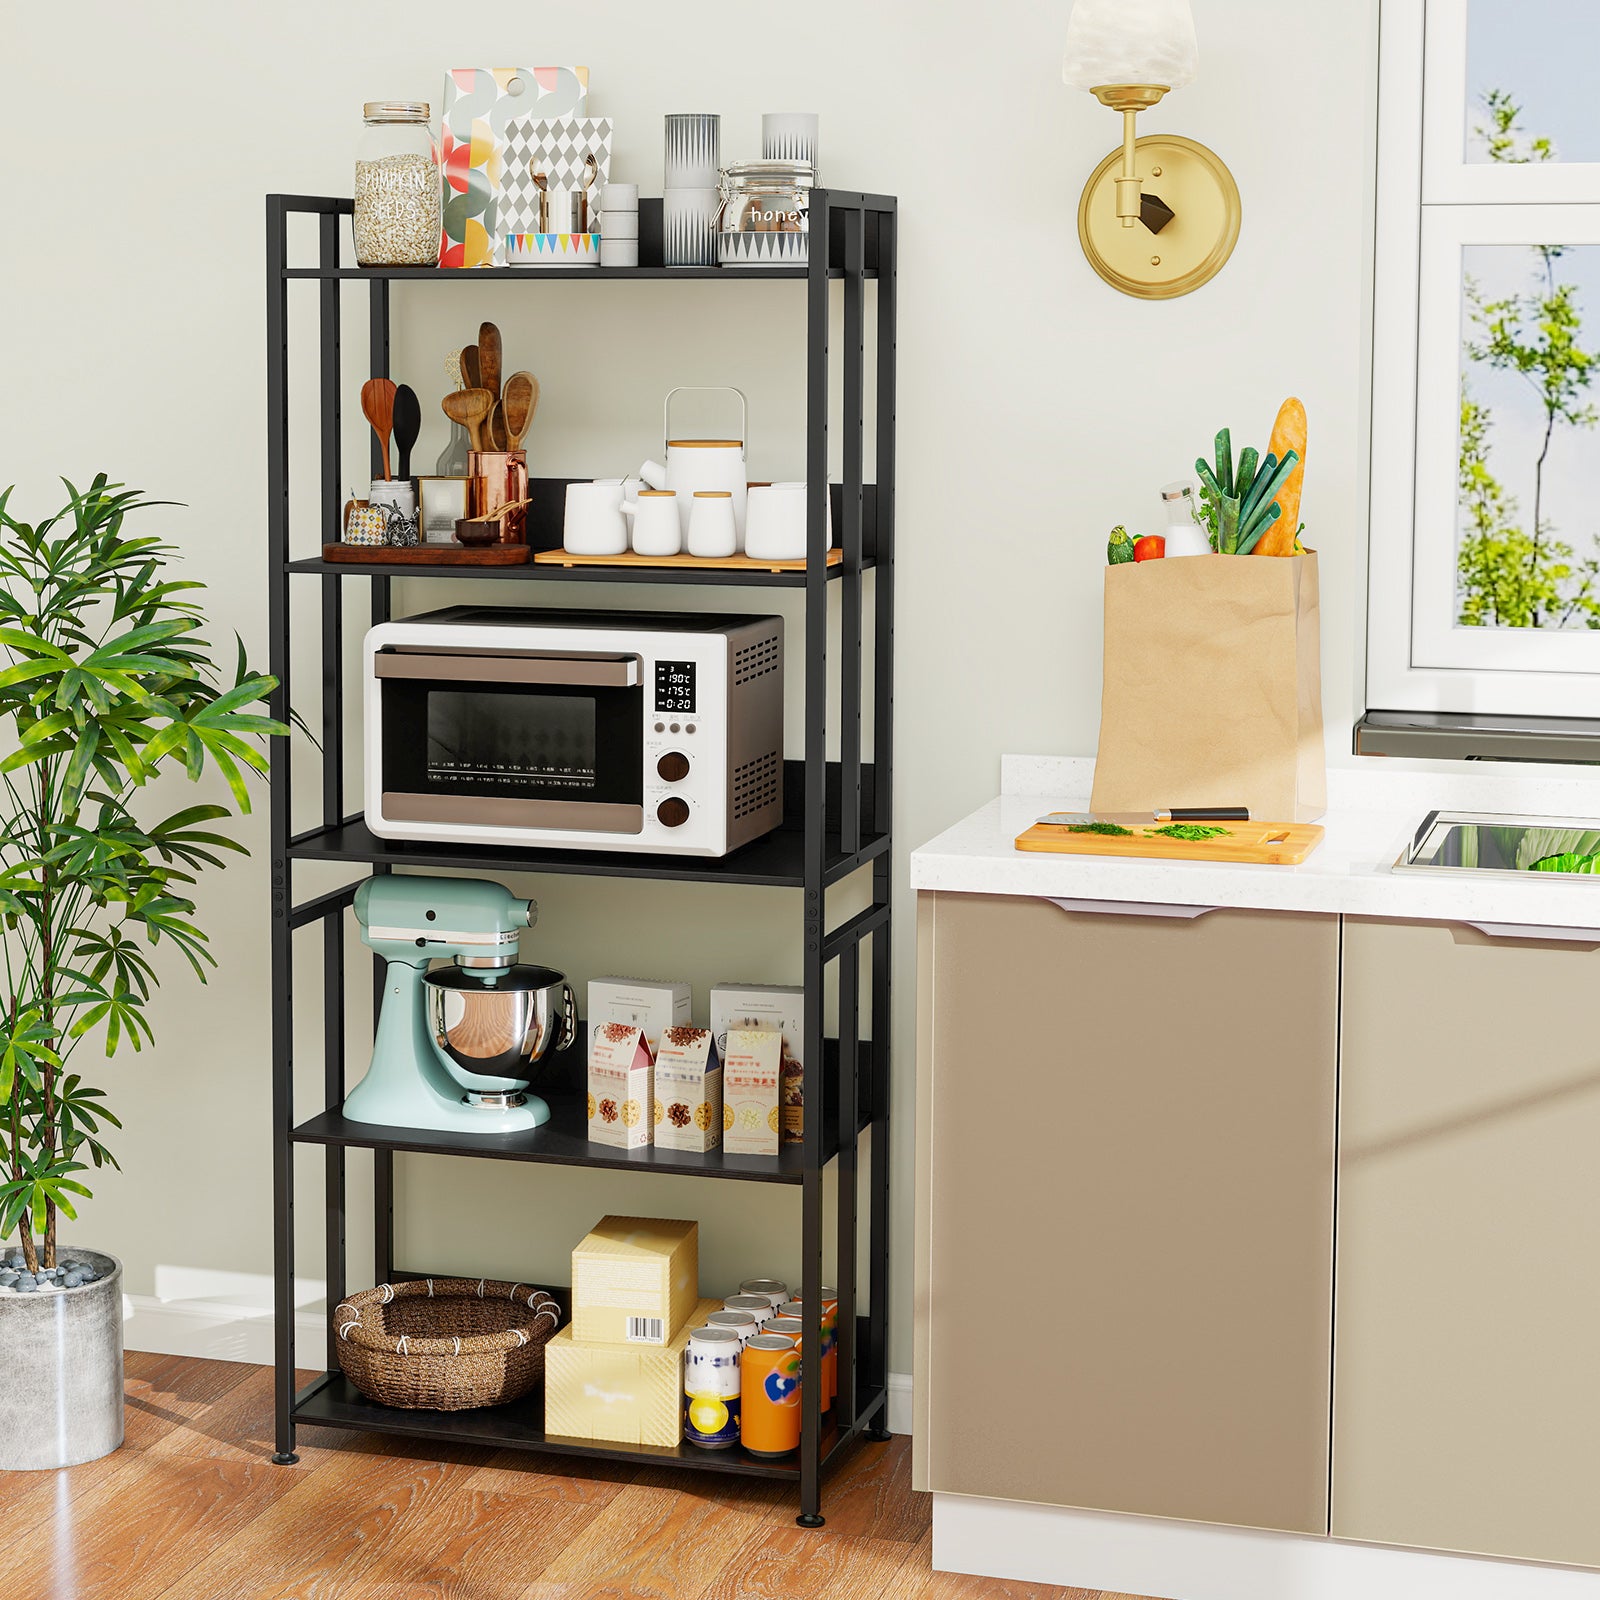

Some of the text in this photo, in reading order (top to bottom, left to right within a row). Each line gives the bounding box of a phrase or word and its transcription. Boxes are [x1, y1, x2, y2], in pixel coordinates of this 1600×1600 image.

[365, 169, 425, 191] PUMPKIN
[371, 200, 416, 219] SEEDS
[751, 206, 809, 227] honey
[666, 699, 690, 709] 0:20
